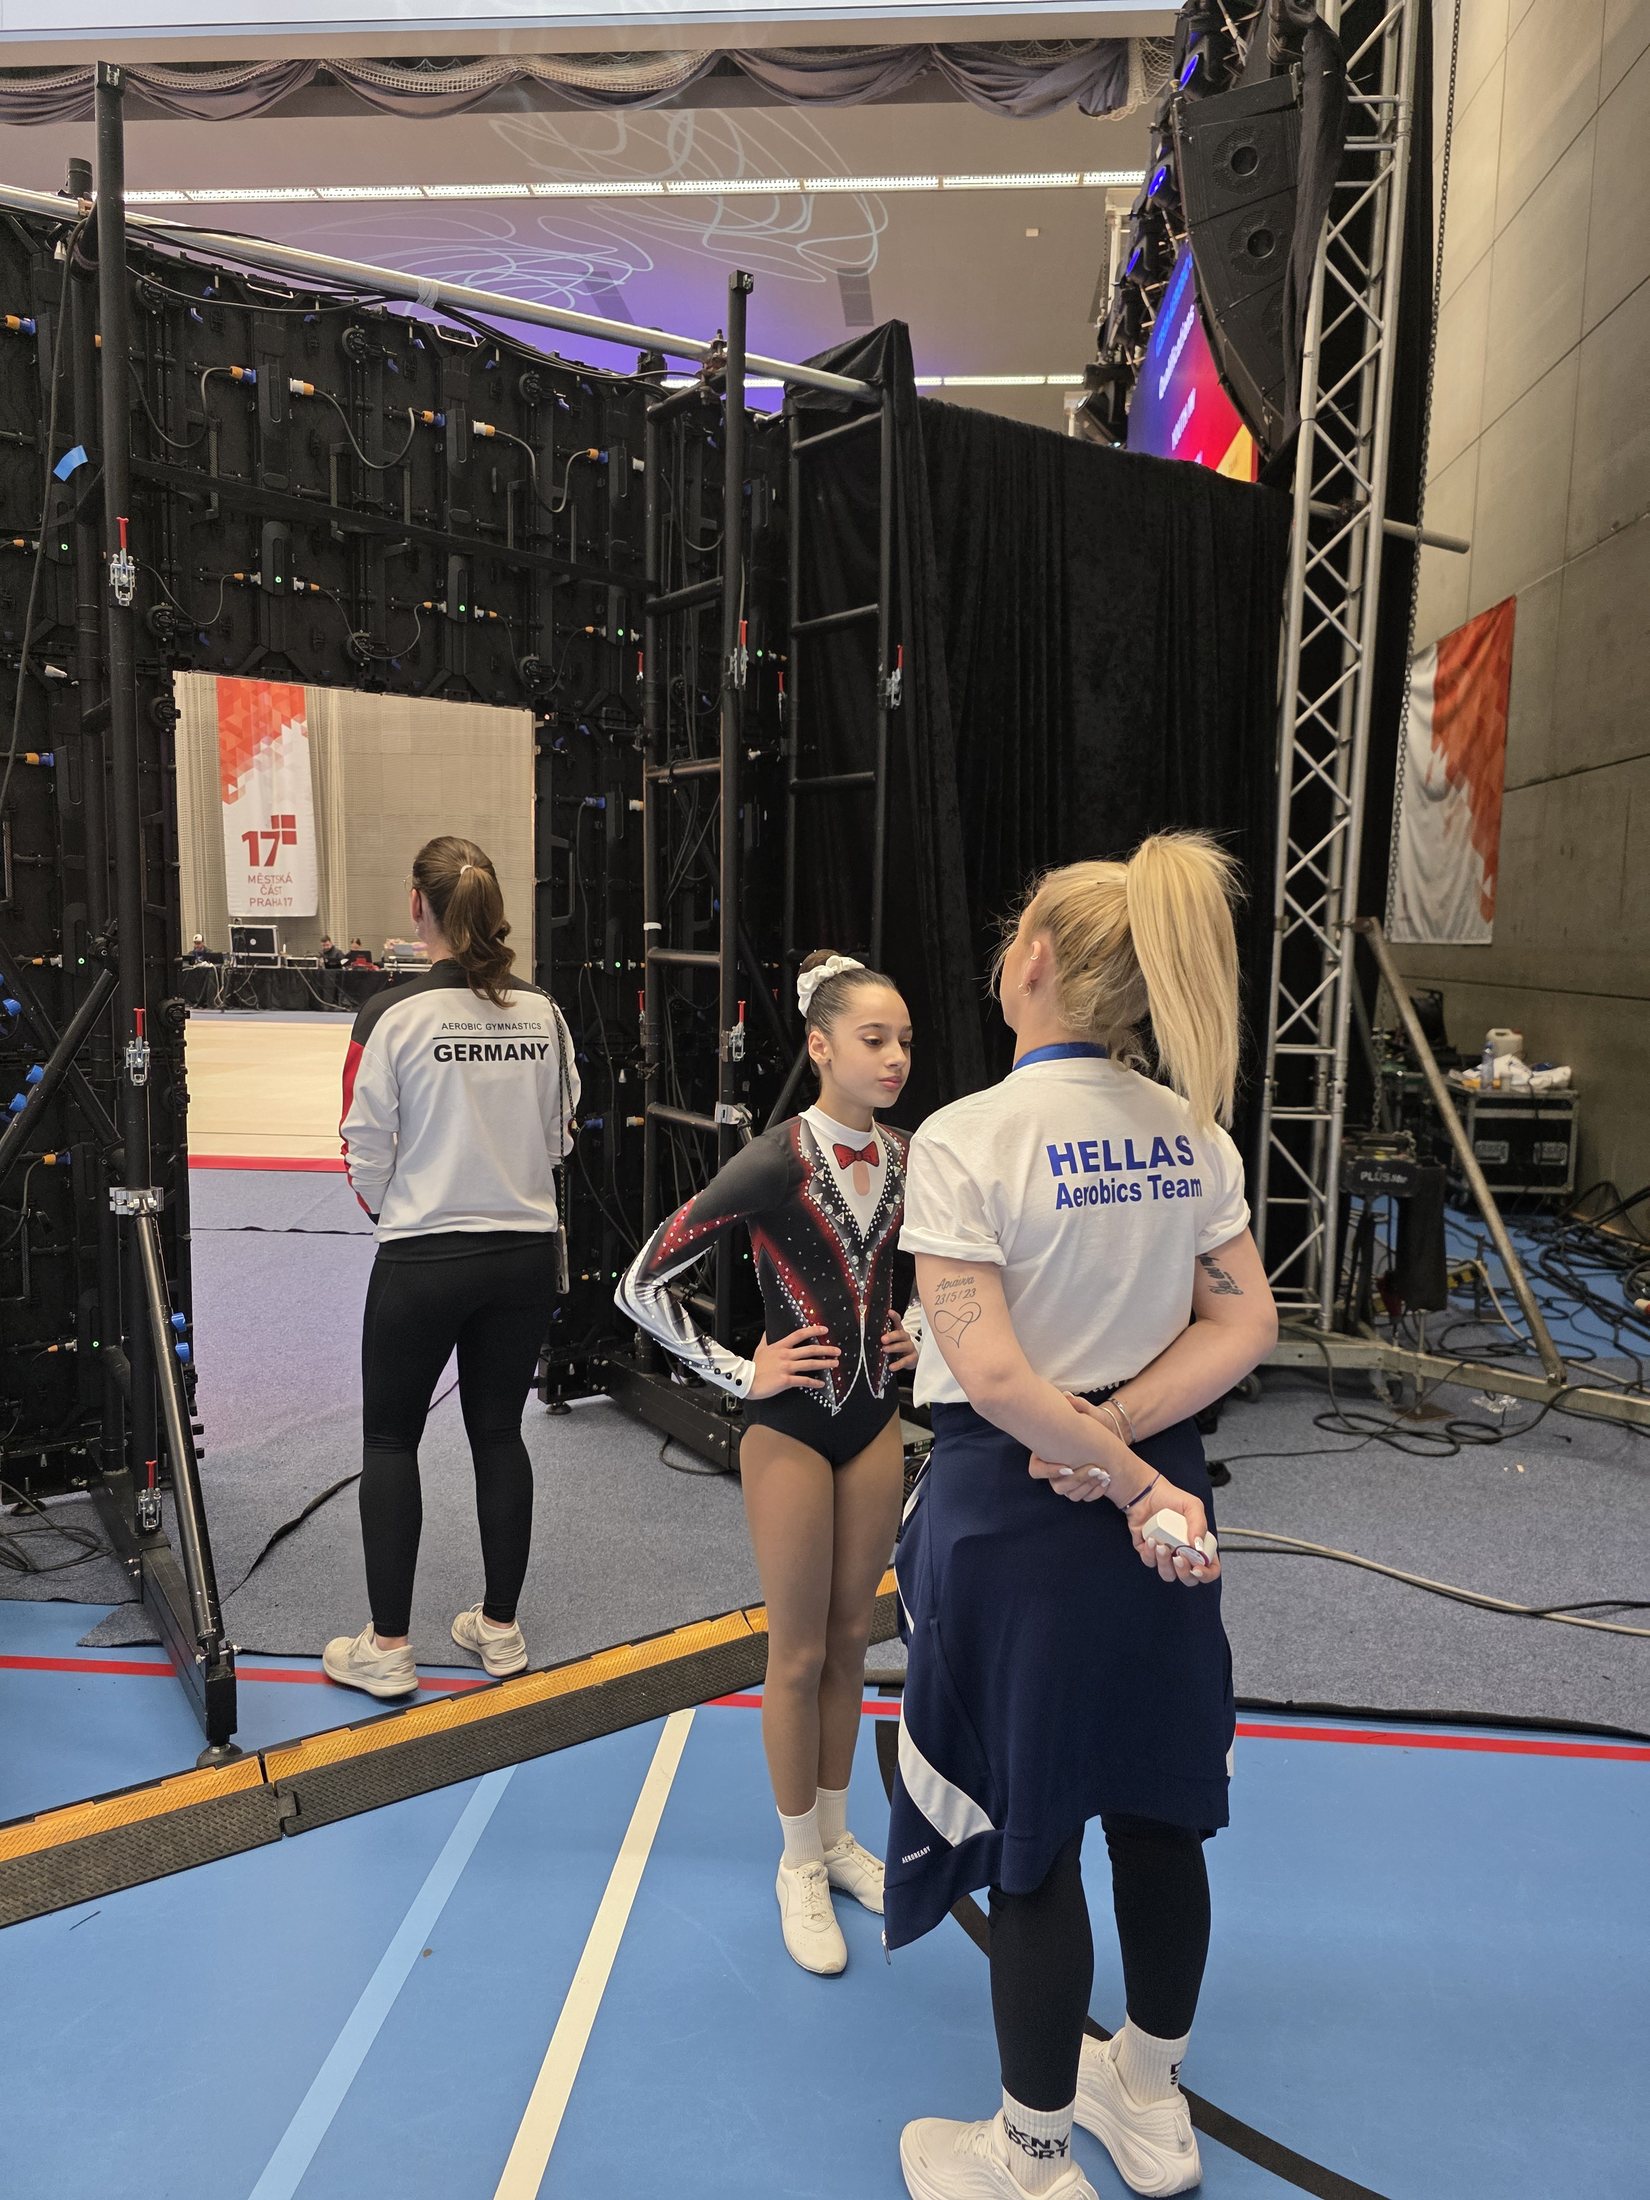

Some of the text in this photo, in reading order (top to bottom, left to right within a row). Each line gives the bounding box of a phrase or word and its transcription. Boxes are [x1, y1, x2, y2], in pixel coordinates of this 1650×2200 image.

[241, 830, 281, 867] 17
[247, 872, 293, 884] MĚSTSKÁ
[260, 884, 282, 896] ČÁST
[249, 897, 293, 907] PRAHA 17
[441, 1022, 542, 1031] AEROBIC GYMNASTICS
[433, 1043, 549, 1063] GERMANY
[1046, 1134, 1195, 1177] HELLAS
[1055, 1174, 1203, 1211] Aerobics Team
[934, 1287, 977, 1306] 23/5/23
[901, 1845, 931, 1864] AEROREADY
